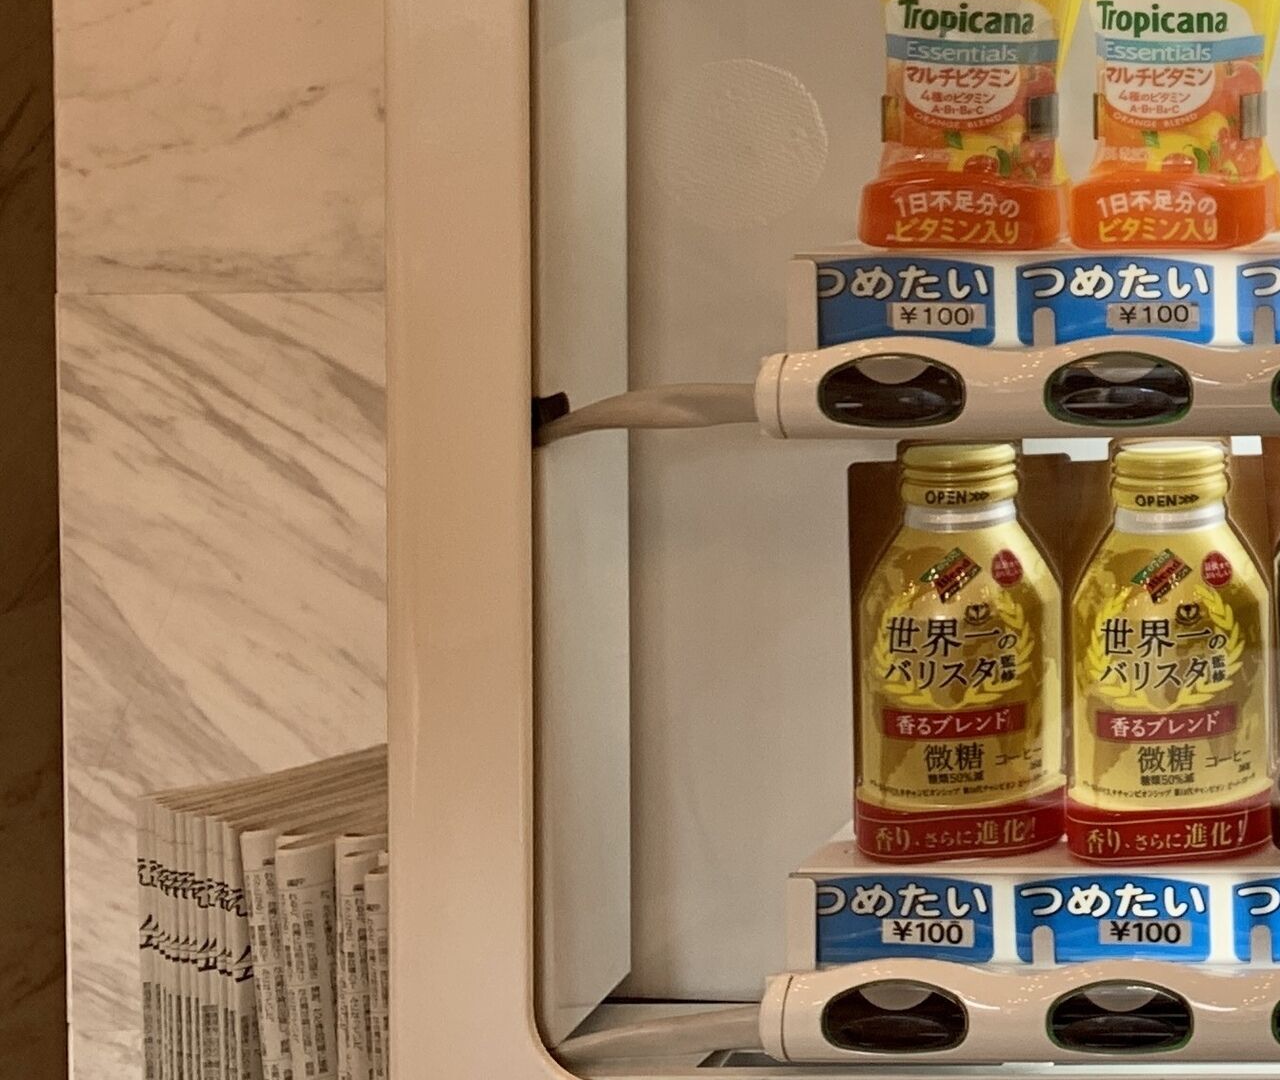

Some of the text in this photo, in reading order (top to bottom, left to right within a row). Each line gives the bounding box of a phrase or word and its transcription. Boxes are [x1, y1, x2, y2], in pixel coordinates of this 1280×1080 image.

[1096, 0, 1229, 39] Tropicana
[905, 41, 1019, 63] Essentials
[1104, 42, 1213, 63] Essentials
[905, 65, 1019, 89] マルチビタミン
[1106, 66, 1217, 90] マルチビタミン
[895, 218, 1021, 245] ビタミン入り
[1099, 218, 1219, 244] ビタミン入り
[1119, 304, 1190, 325] ¥100
[896, 709, 1011, 736] 香るブレンド
[1111, 708, 1220, 738] 香るブレンド
[995, 748, 1042, 768] コーヒー
[1205, 749, 1252, 769] コーヒー
[893, 921, 963, 945] ¥100
[1109, 919, 1183, 943] ¥100
